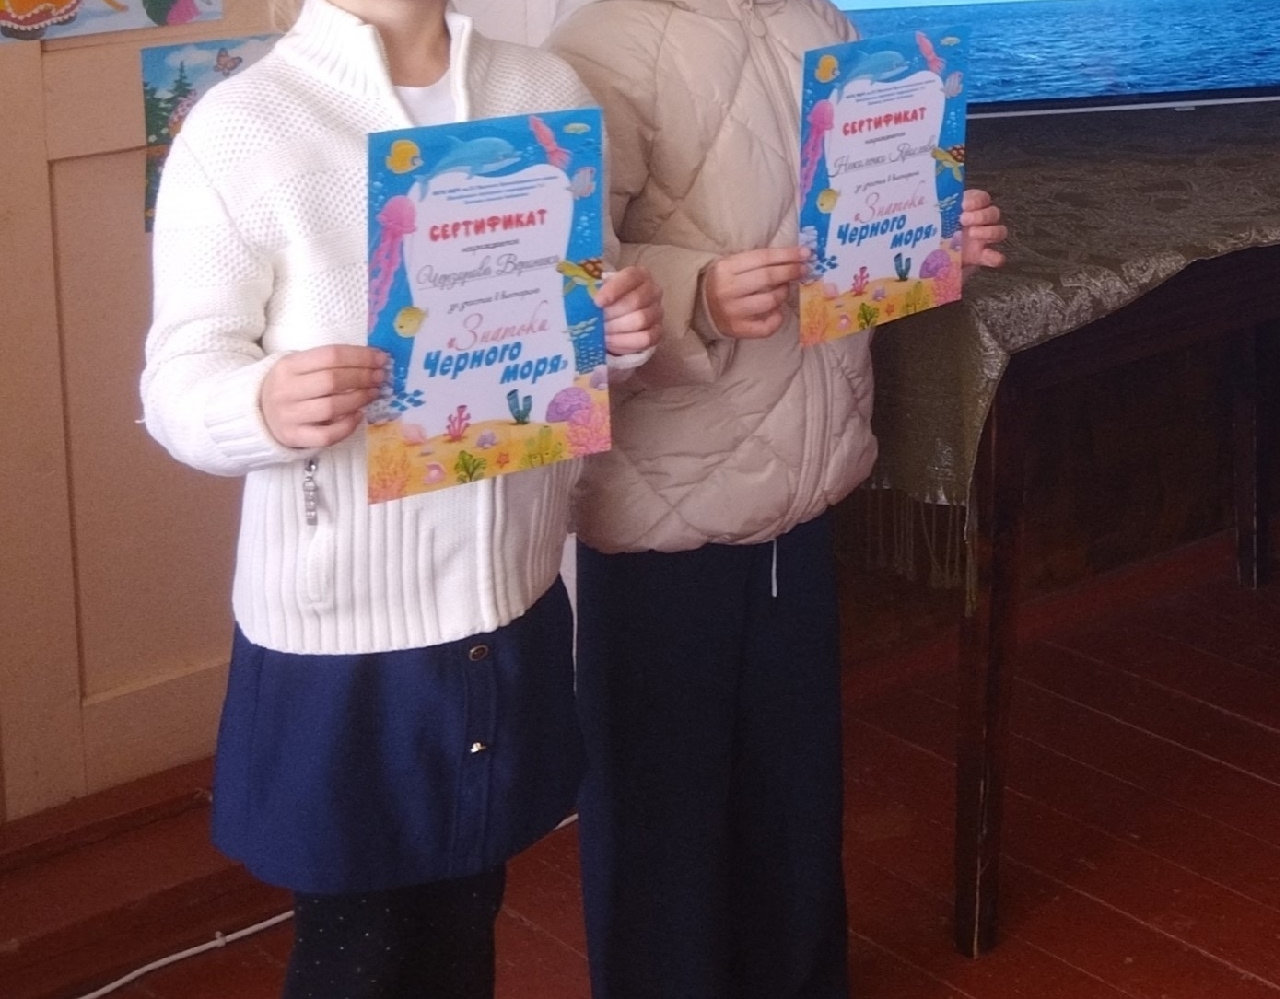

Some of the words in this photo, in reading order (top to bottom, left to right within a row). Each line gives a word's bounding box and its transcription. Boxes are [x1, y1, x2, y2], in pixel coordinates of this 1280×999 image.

[842, 107, 927, 137] СЕРТИФИКАТ
[429, 209, 548, 242] СЕРТИФИКАТ
[837, 214, 907, 247] Черного
[423, 341, 522, 378] Черного
